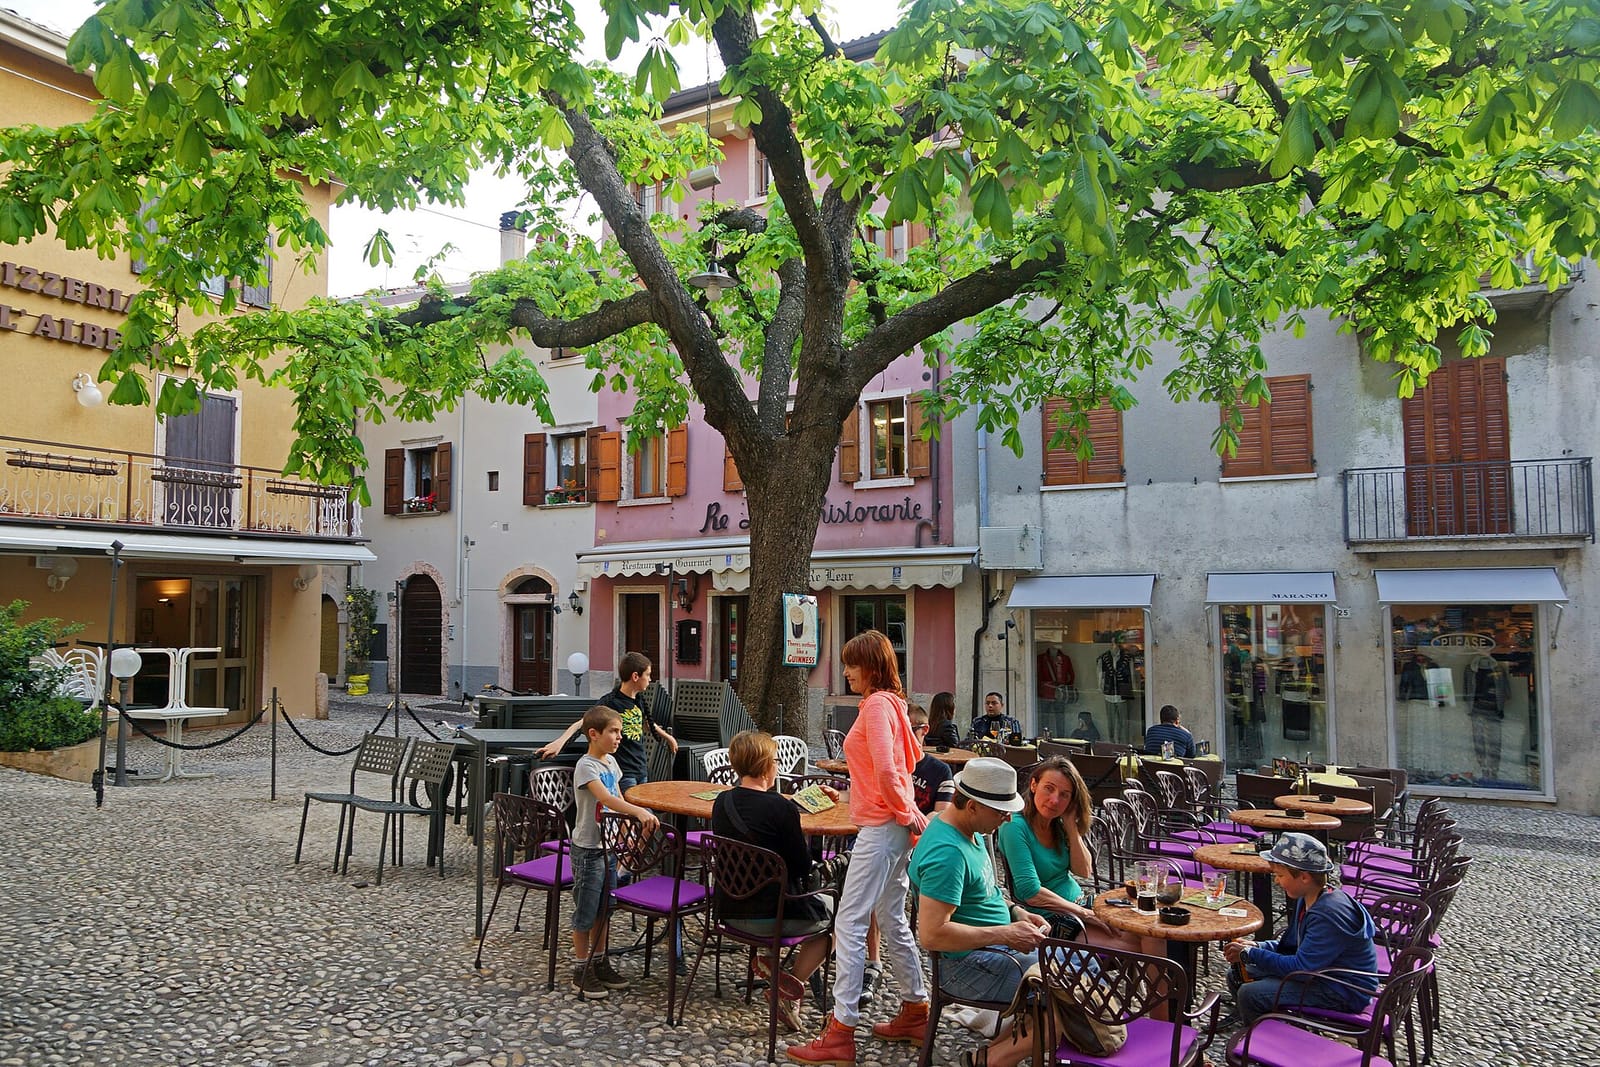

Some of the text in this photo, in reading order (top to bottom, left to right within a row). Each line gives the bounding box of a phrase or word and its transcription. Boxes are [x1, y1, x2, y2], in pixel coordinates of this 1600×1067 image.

[699, 501, 729, 532] Re
[675, 557, 712, 568] Gourmet
[825, 568, 854, 582] Lear
[1441, 637, 1487, 649] PLEASE
[787, 655, 815, 665] GUINNESS
